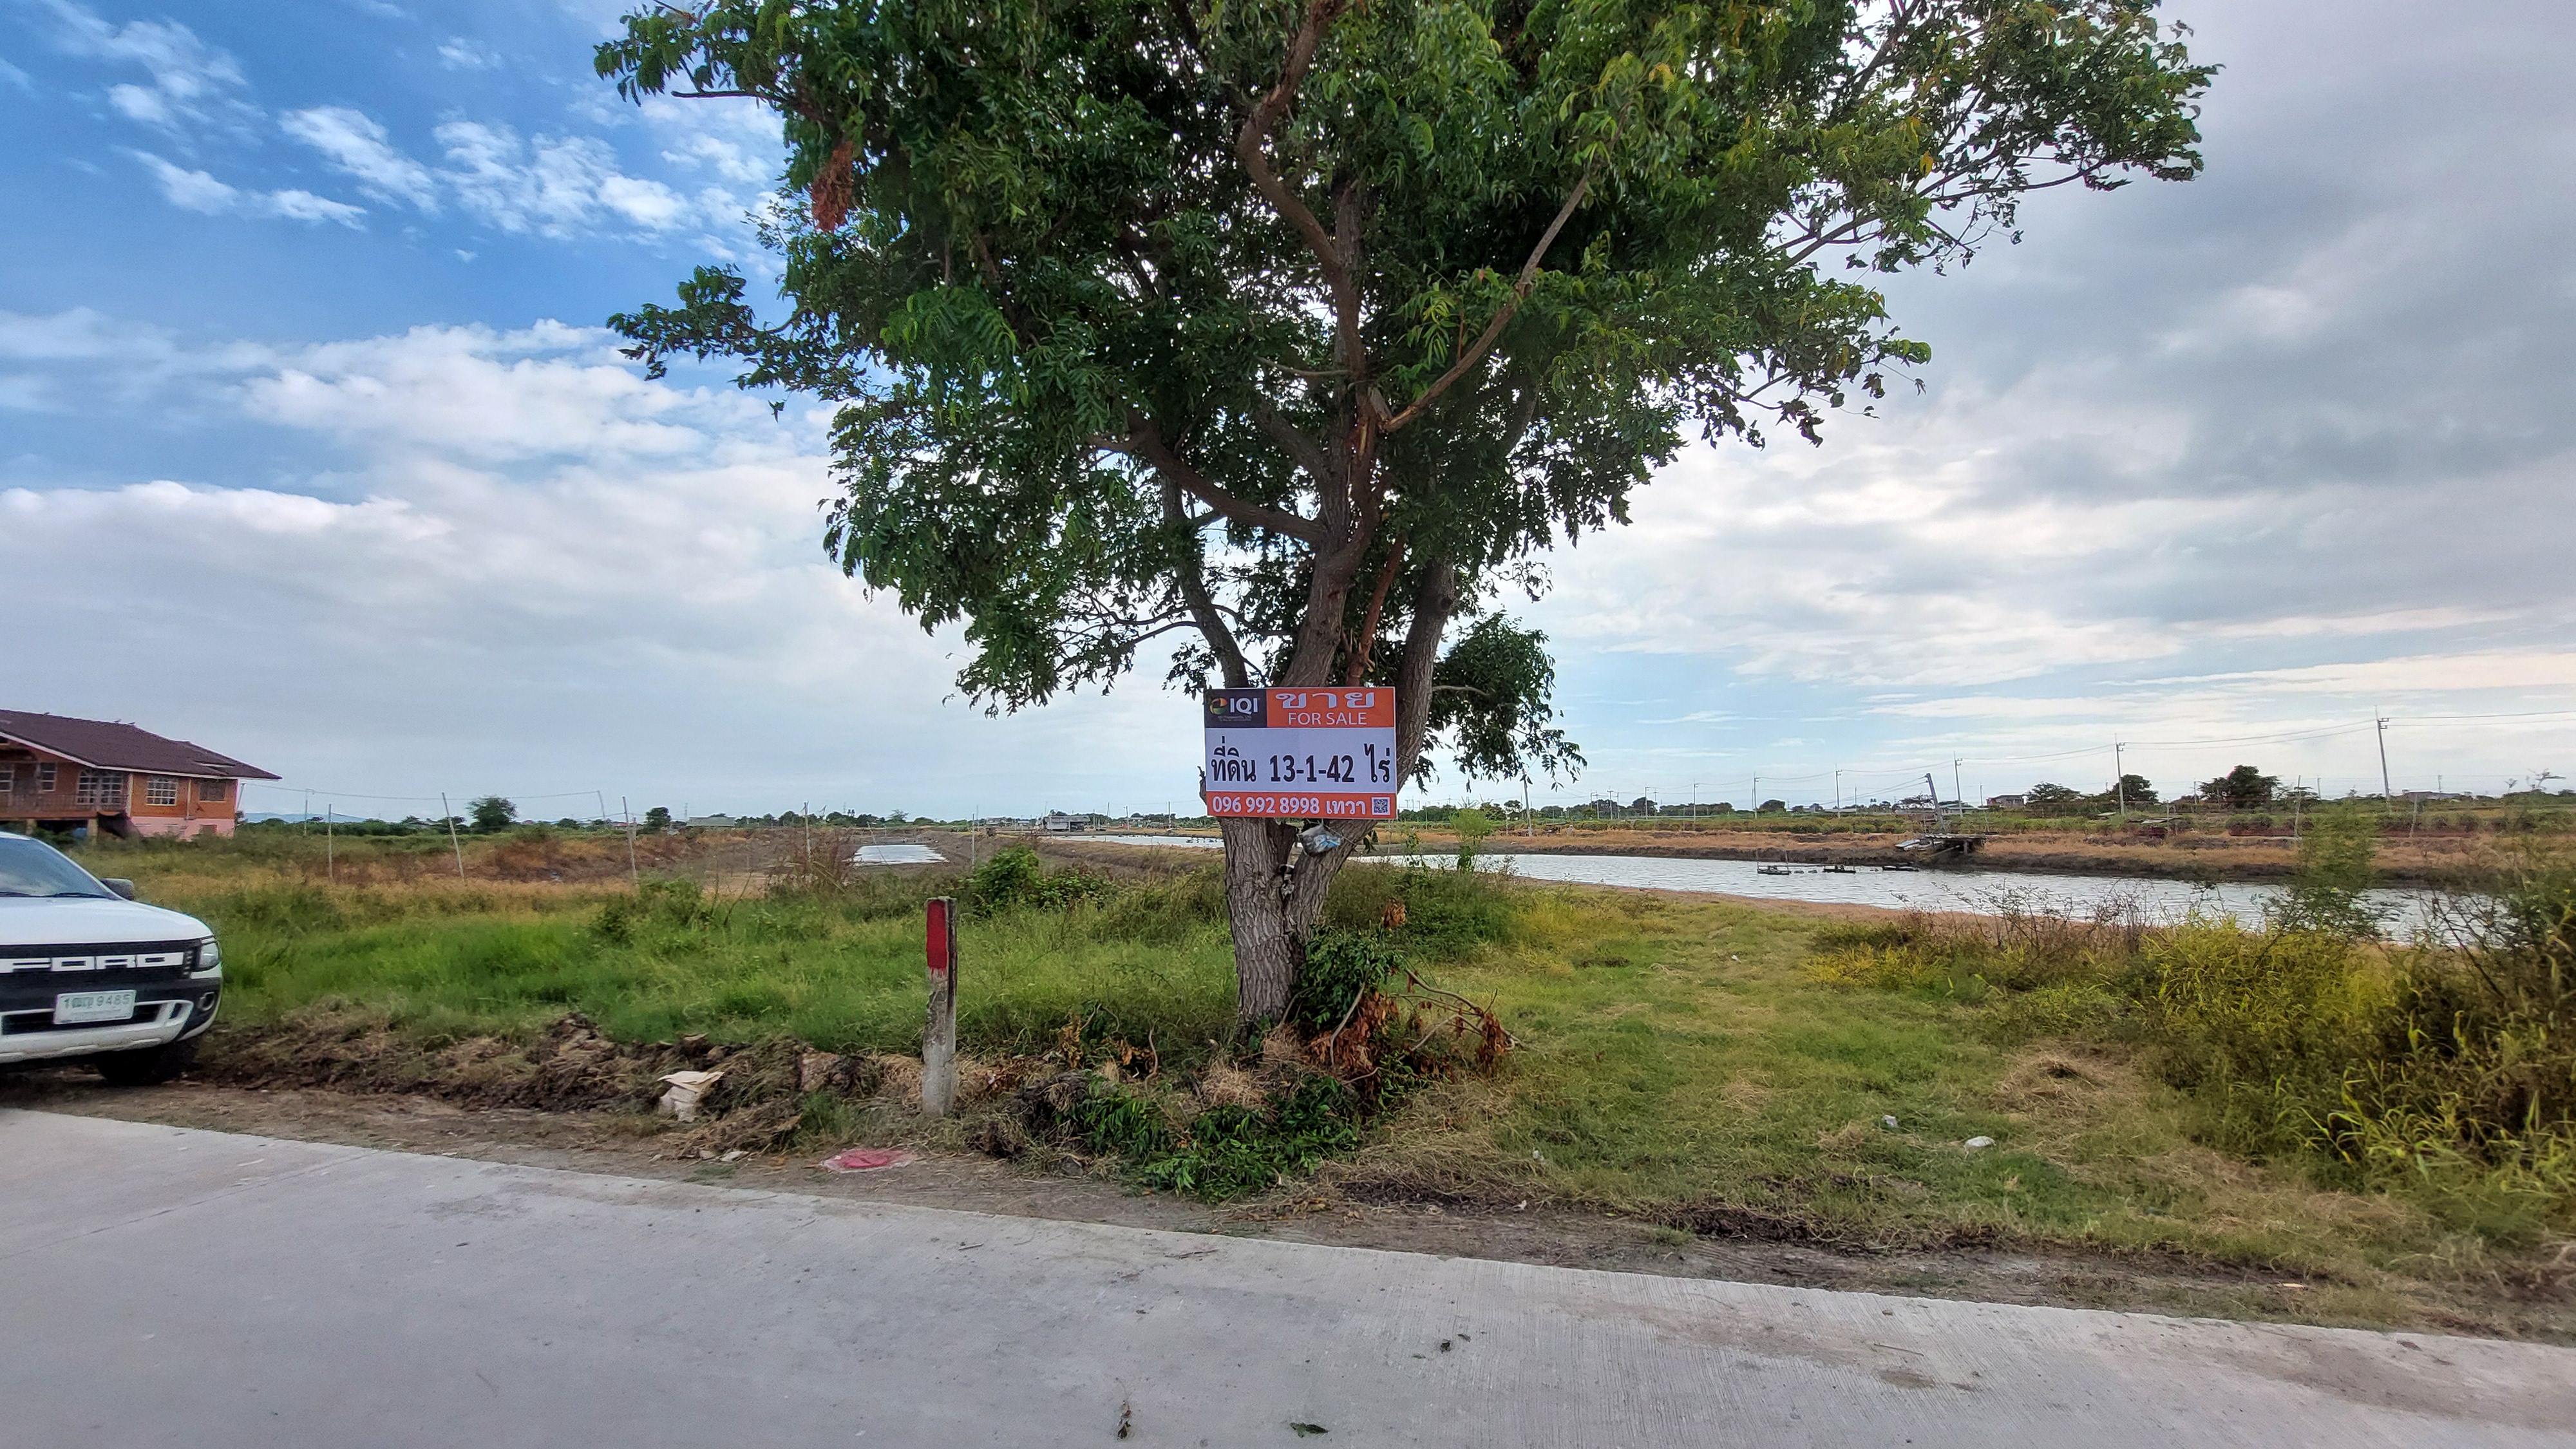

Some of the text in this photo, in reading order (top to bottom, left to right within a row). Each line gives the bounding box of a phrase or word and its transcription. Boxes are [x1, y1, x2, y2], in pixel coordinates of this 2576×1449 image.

[1230, 697, 1258, 715] IQI
[1275, 692, 1375, 709] ขาย
[1288, 712, 1367, 726] FOR SALE
[1211, 735, 1391, 783] ที่ดิน 13-1-42 ไร่
[1212, 796, 1366, 815] 096 992 8998 เทวา
